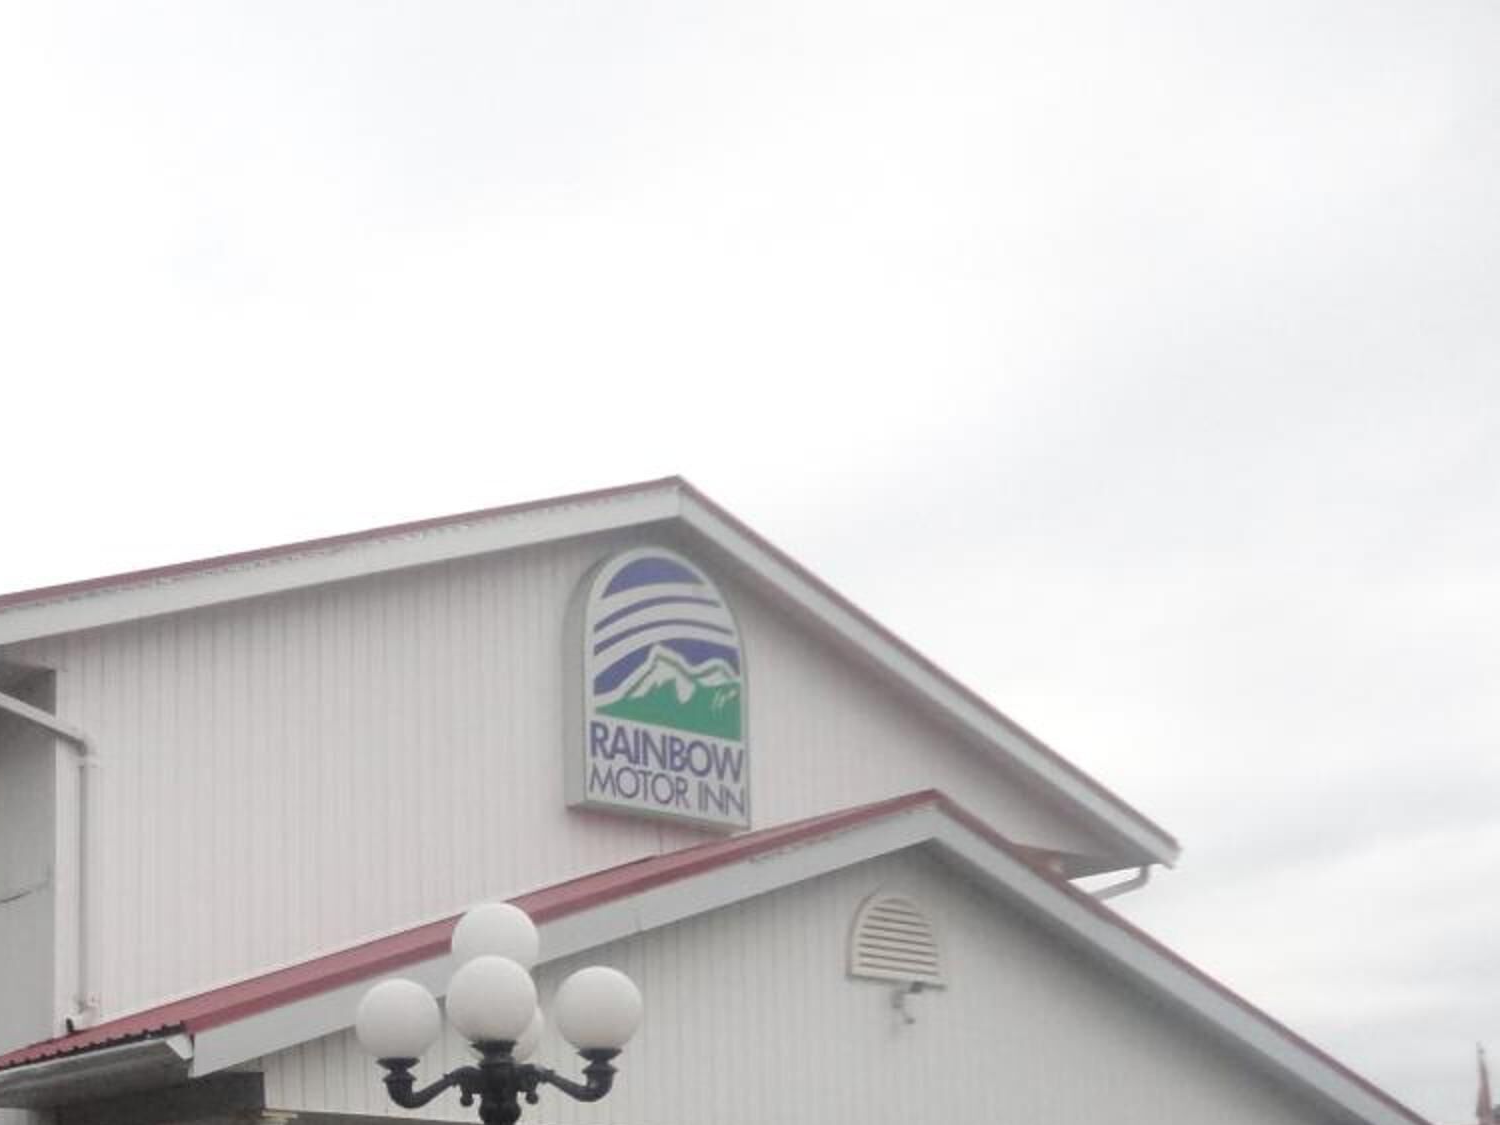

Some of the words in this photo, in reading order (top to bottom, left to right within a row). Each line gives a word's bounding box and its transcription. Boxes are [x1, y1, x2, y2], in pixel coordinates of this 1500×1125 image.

[590, 720, 743, 782] RAINBOW
[589, 763, 690, 809] MOTOR
[698, 783, 745, 816] INN
